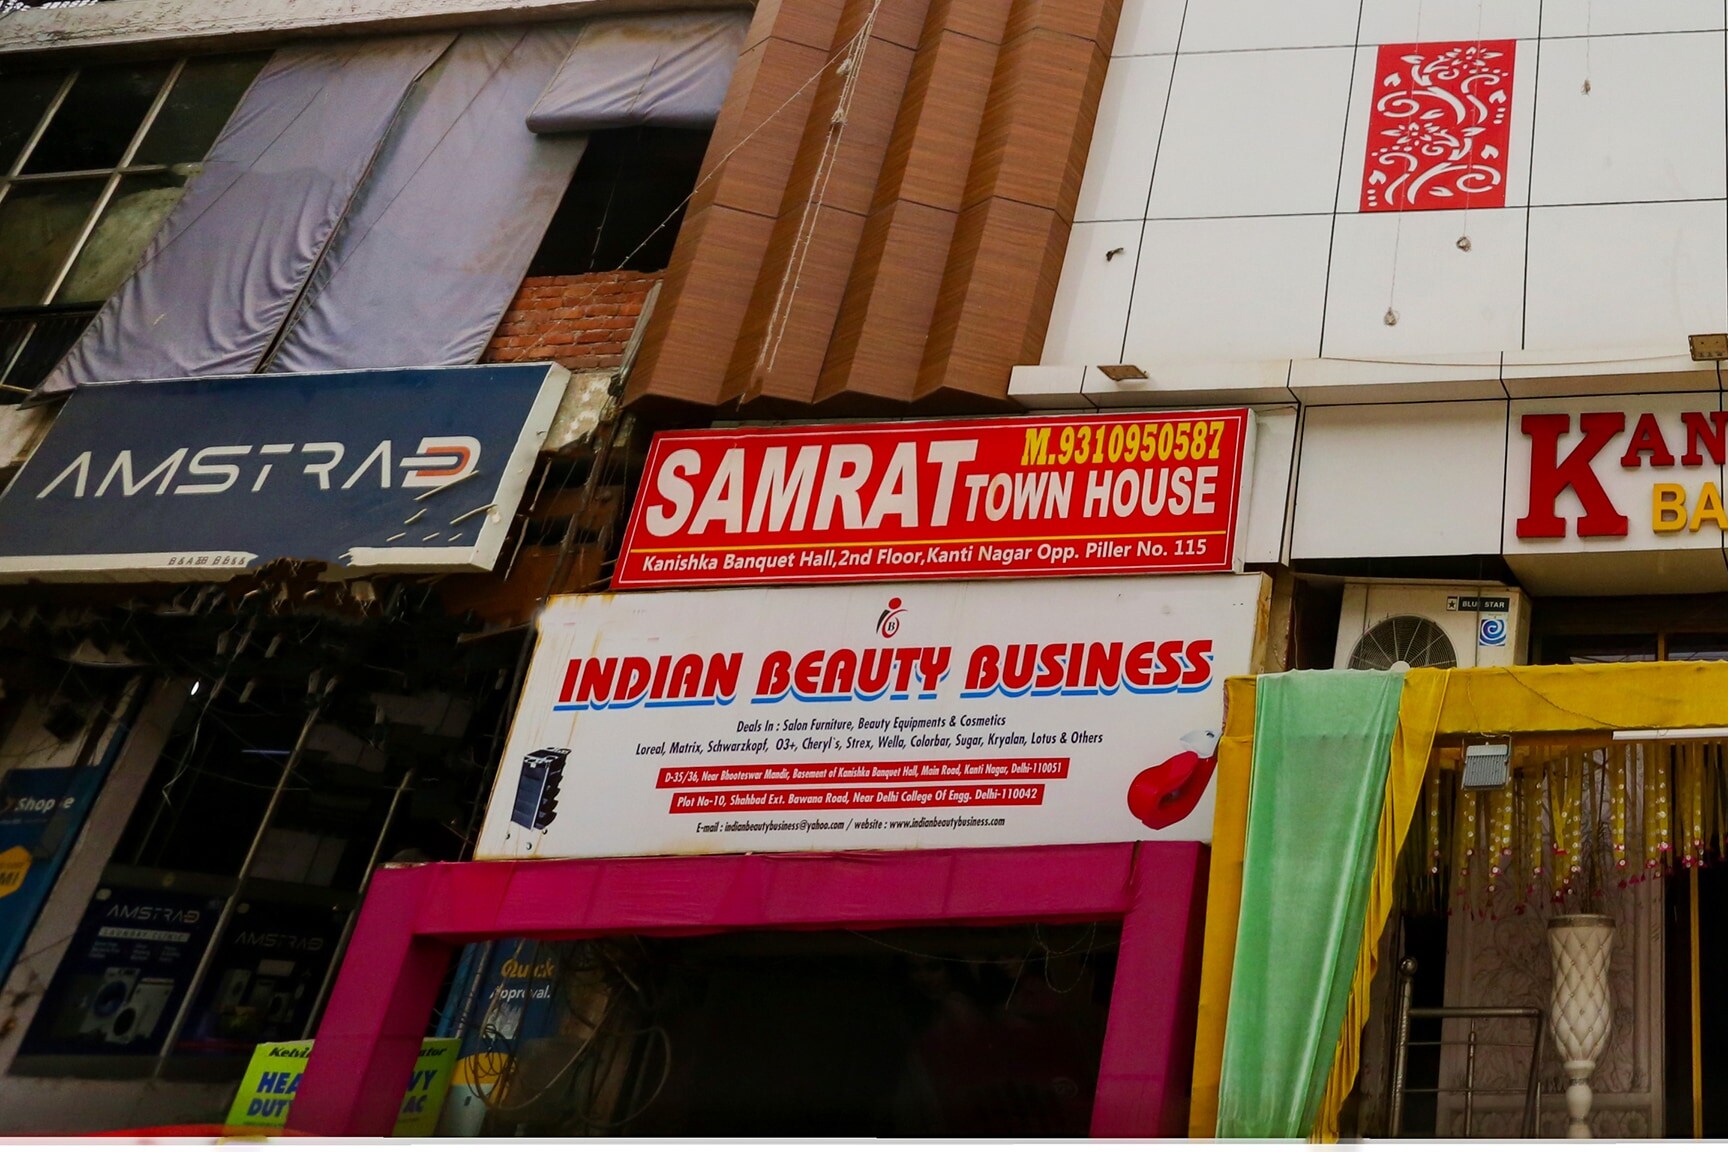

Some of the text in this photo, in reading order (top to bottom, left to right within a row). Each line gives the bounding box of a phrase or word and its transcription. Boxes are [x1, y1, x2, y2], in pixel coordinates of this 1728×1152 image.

[1021, 421, 1225, 467] M.9310950587
[36, 436, 482, 500] AMSTRAD
[645, 438, 1219, 538] SAMRAT TOWN HOUSE
[642, 554, 718, 572] Kanishka
[722, 552, 796, 573] Banquet
[977, 545, 1033, 566] Nagar
[1036, 543, 1080, 564] Opp.
[1085, 541, 1132, 559] Piller
[1136, 540, 1168, 557] No.
[1173, 538, 1208, 556] 115
[1462, 600, 1505, 609] BLU STAR
[556, 639, 1214, 704] INDIAN BEAUTY BUSINESS
[736, 720, 762, 733] Deals
[783, 719, 808, 732] Salon
[810, 718, 855, 731] Furniture,
[857, 717, 890, 732] Beauty
[893, 716, 946, 731] Equipments
[949, 715, 956, 727] &
[960, 714, 1007, 727] Cosmetics
[636, 742, 666, 756] Loreal,
[669, 741, 704, 755] Matrix,
[707, 739, 769, 755] Schwarzkopf,
[846, 737, 874, 750] Strex,
[878, 734, 907, 749] Wella,
[910, 733, 952, 748] Colorbar,
[955, 733, 984, 749] Sugar,
[987, 732, 1027, 749] Kryalan,
[1031, 731, 1057, 745] Lotus
[1059, 731, 1068, 744] &
[1071, 730, 1104, 745] Others
[664, 770, 699, 783] D-35/36,
[701, 770, 719, 782] Near
[792, 767, 828, 780] Basement
[837, 765, 870, 778] Kanishka
[871, 764, 902, 780] Banquet
[902, 764, 919, 778] Hall,
[921, 764, 940, 776] Main
[940, 763, 962, 777] Road,
[963, 763, 984, 776] Kanti
[984, 763, 1009, 777] Nagar,
[1011, 761, 1062, 774] Delhi-110051
[676, 787, 1038, 808] Plot No-10, Shahbad Ext. Bawana Road, Near Delhi College Of Engg. Delhi-110042
[696, 821, 719, 833] E-mail
[724, 819, 845, 835] indianbeautybusiness@yahoo.com
[854, 818, 883, 830] website
[889, 816, 1006, 831] www.indianbeautybusiness.com
[106, 904, 200, 924] AMSTRAD
[235, 931, 324, 952] AMSTRAD
[500, 957, 556, 979] Quck
[256, 1071, 305, 1095] HEA
[246, 1097, 292, 1118] DUT
